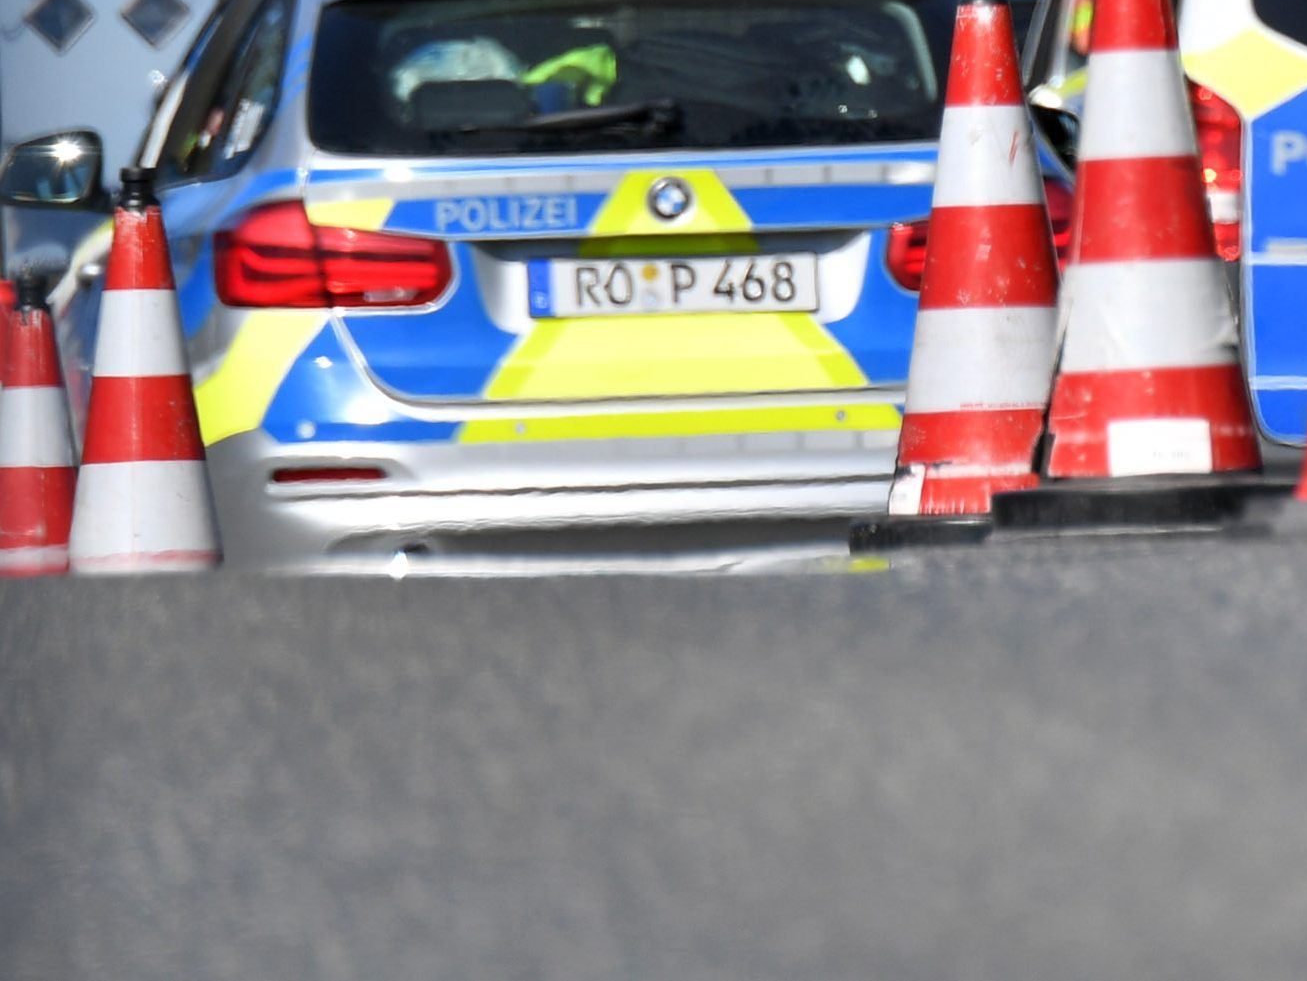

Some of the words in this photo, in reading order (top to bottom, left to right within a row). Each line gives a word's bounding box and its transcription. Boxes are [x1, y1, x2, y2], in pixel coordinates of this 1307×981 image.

[435, 194, 577, 234] POLIZEI
[575, 263, 633, 308] RO
[671, 263, 696, 303] P
[713, 260, 796, 304] 468
